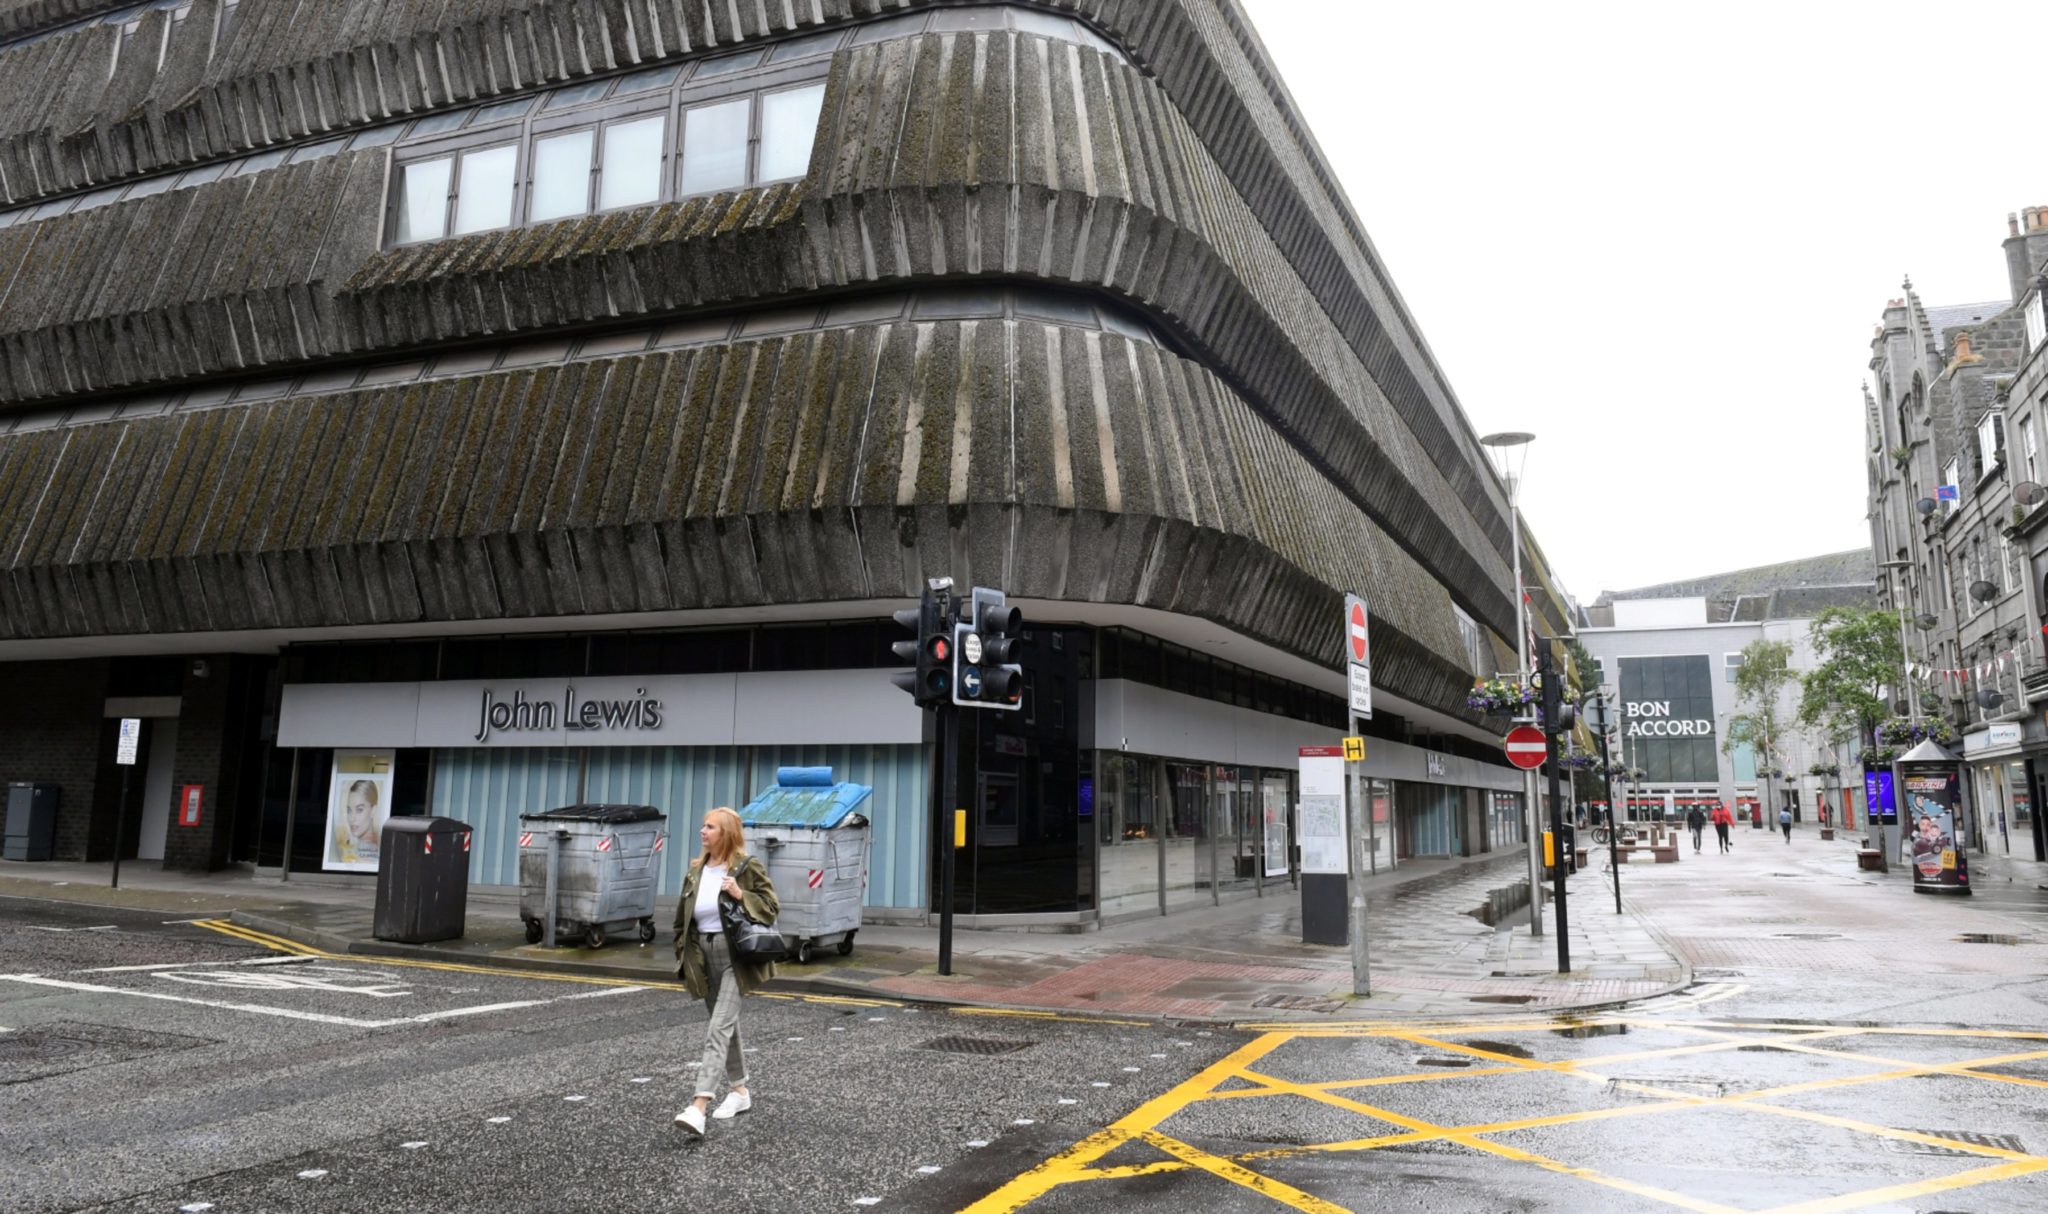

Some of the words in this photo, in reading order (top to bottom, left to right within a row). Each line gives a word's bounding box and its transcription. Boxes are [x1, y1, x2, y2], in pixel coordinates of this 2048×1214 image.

[475, 688, 556, 742] John
[563, 685, 662, 731] Lewis
[1626, 701, 1670, 717] BON
[1627, 719, 1711, 736] ACCORD
[1346, 740, 1362, 758] H
